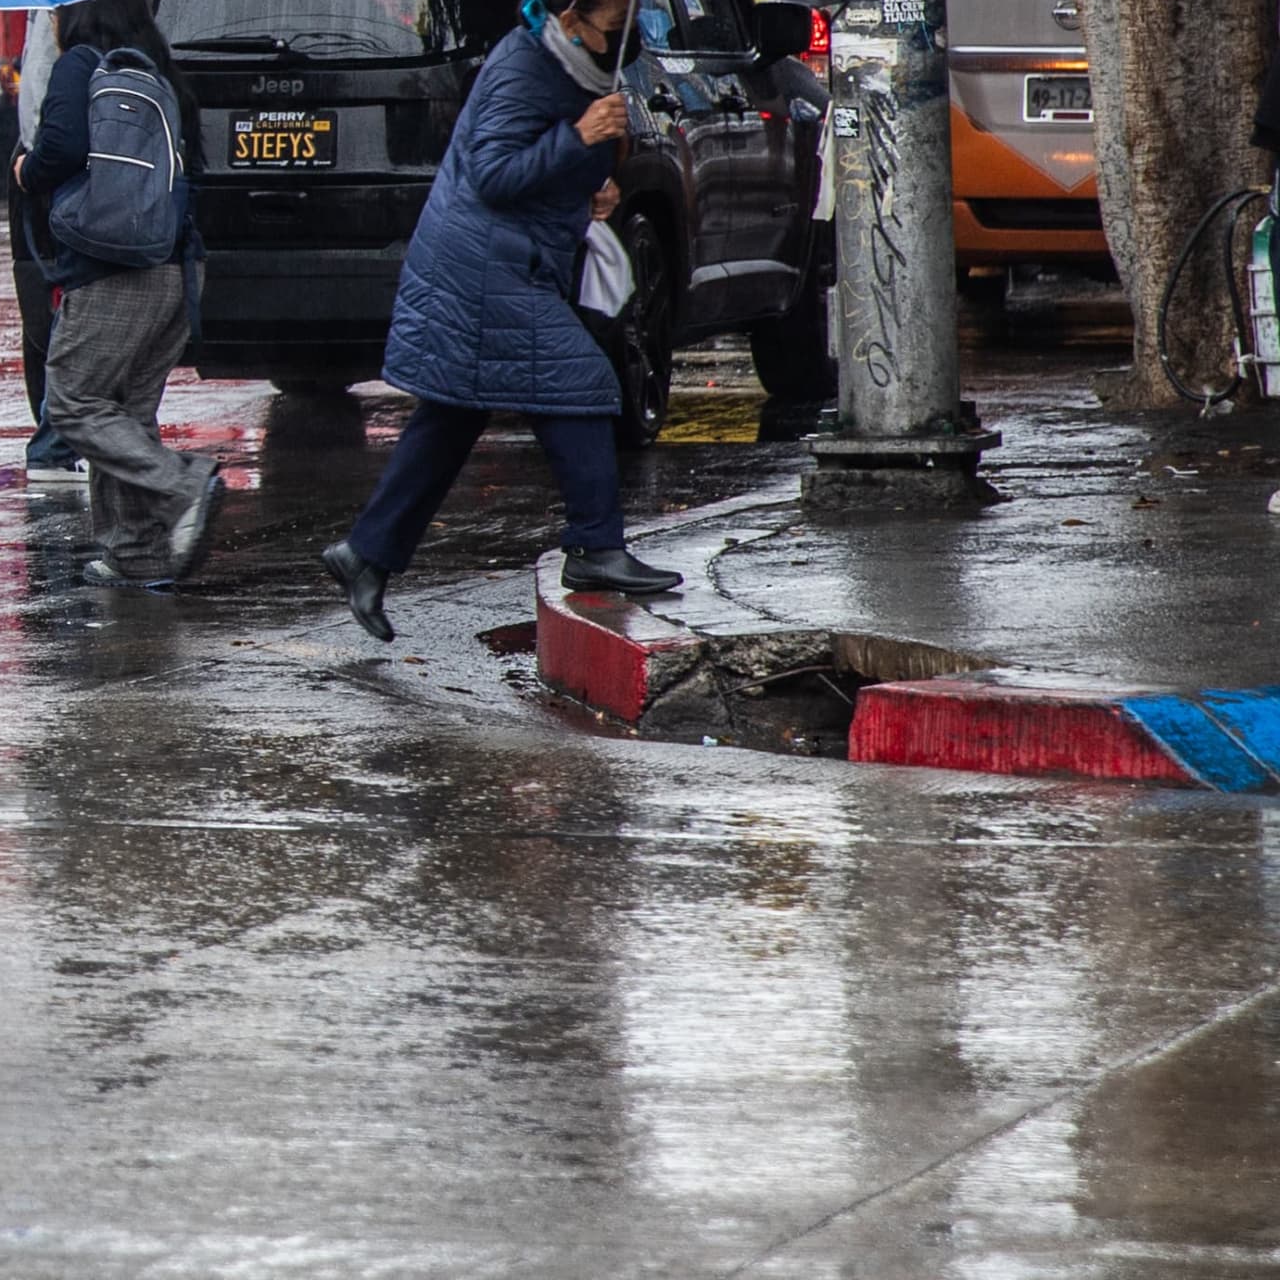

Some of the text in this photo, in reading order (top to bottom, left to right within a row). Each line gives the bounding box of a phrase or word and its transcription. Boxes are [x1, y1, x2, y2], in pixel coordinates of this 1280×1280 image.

[883, 1, 926, 12] CIA CREW
[884, 11, 926, 23] TIJUANA
[252, 75, 305, 96] Jeep
[259, 111, 306, 121] PERRY
[255, 121, 311, 129] CALIFORNIA
[235, 132, 316, 159] STEFYS
